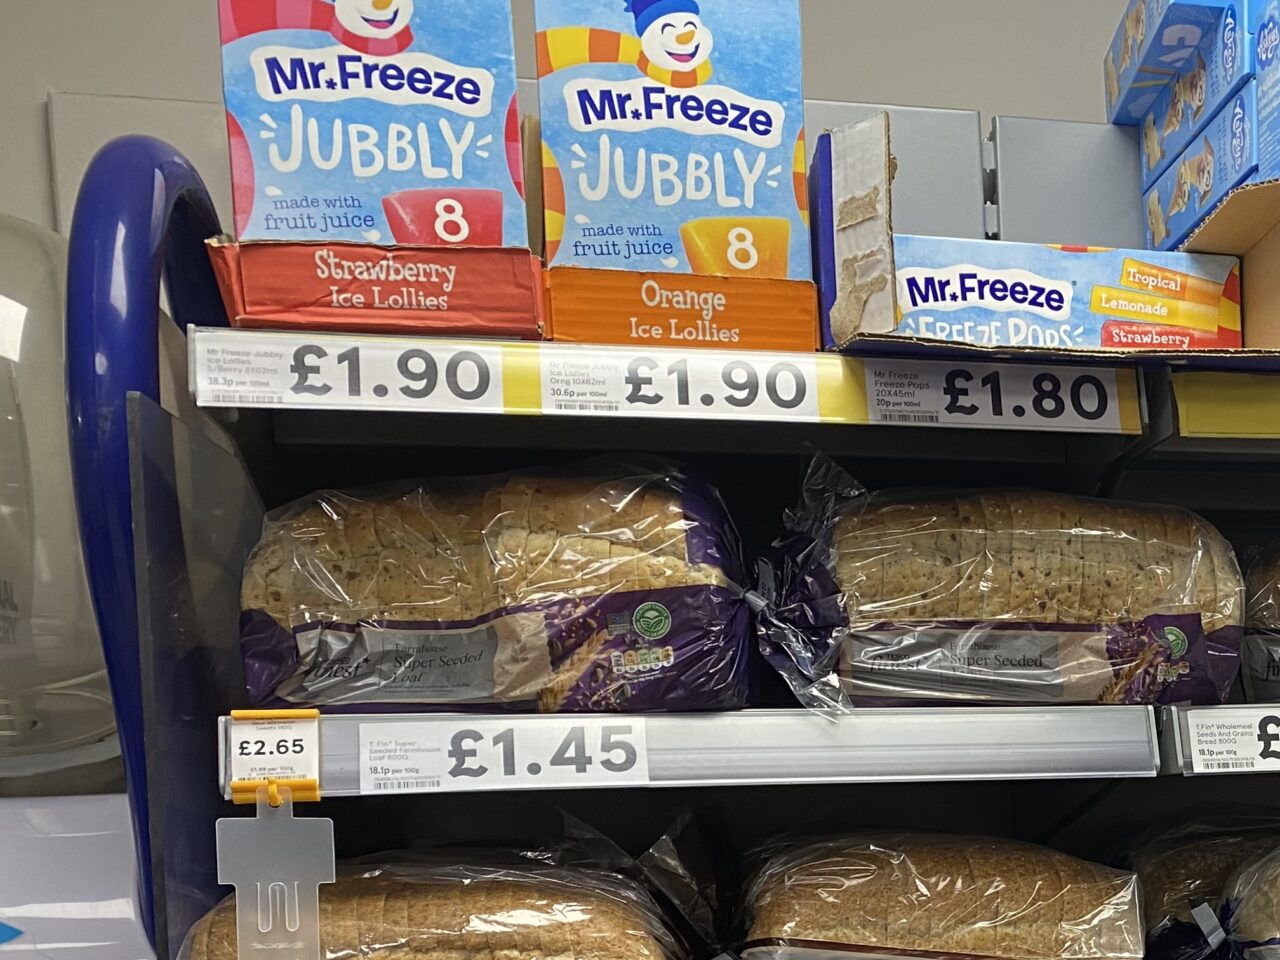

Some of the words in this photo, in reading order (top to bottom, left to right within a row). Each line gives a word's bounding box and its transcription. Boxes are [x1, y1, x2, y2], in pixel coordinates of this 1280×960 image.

[269, 104, 475, 180] JUBBLY
[578, 135, 767, 208] JUBBLY
[272, 195, 319, 211] made
[325, 195, 364, 210] with
[264, 211, 316, 231] fruit
[320, 210, 375, 231] juice
[434, 198, 469, 243] 8
[581, 224, 623, 238] made
[627, 223, 662, 237] with
[573, 240, 618, 257] fruit
[623, 239, 674, 259] juice
[727, 226, 758, 270] 8
[315, 250, 457, 291] Strawberry
[1127, 267, 1181, 292] Tropical
[329, 286, 365, 309] Ice
[371, 288, 449, 311] Lollies
[641, 280, 726, 320] Orange
[1101, 294, 1168, 316] Lemonade
[630, 317, 662, 339] Ice
[669, 319, 740, 344] Lollies
[1112, 329, 1190, 348] Strawberry
[290, 344, 490, 400] £1.90
[625, 357, 807, 409] £1.90
[943, 368, 1108, 421] £1.80
[394, 655, 434, 670] Super
[439, 650, 483, 667] Seeded
[951, 655, 991, 668] Super
[996, 654, 1043, 667] Seeded
[1218, 730, 1231, 738] And
[239, 739, 304, 756] £2.65
[447, 727, 637, 778] £1.45
